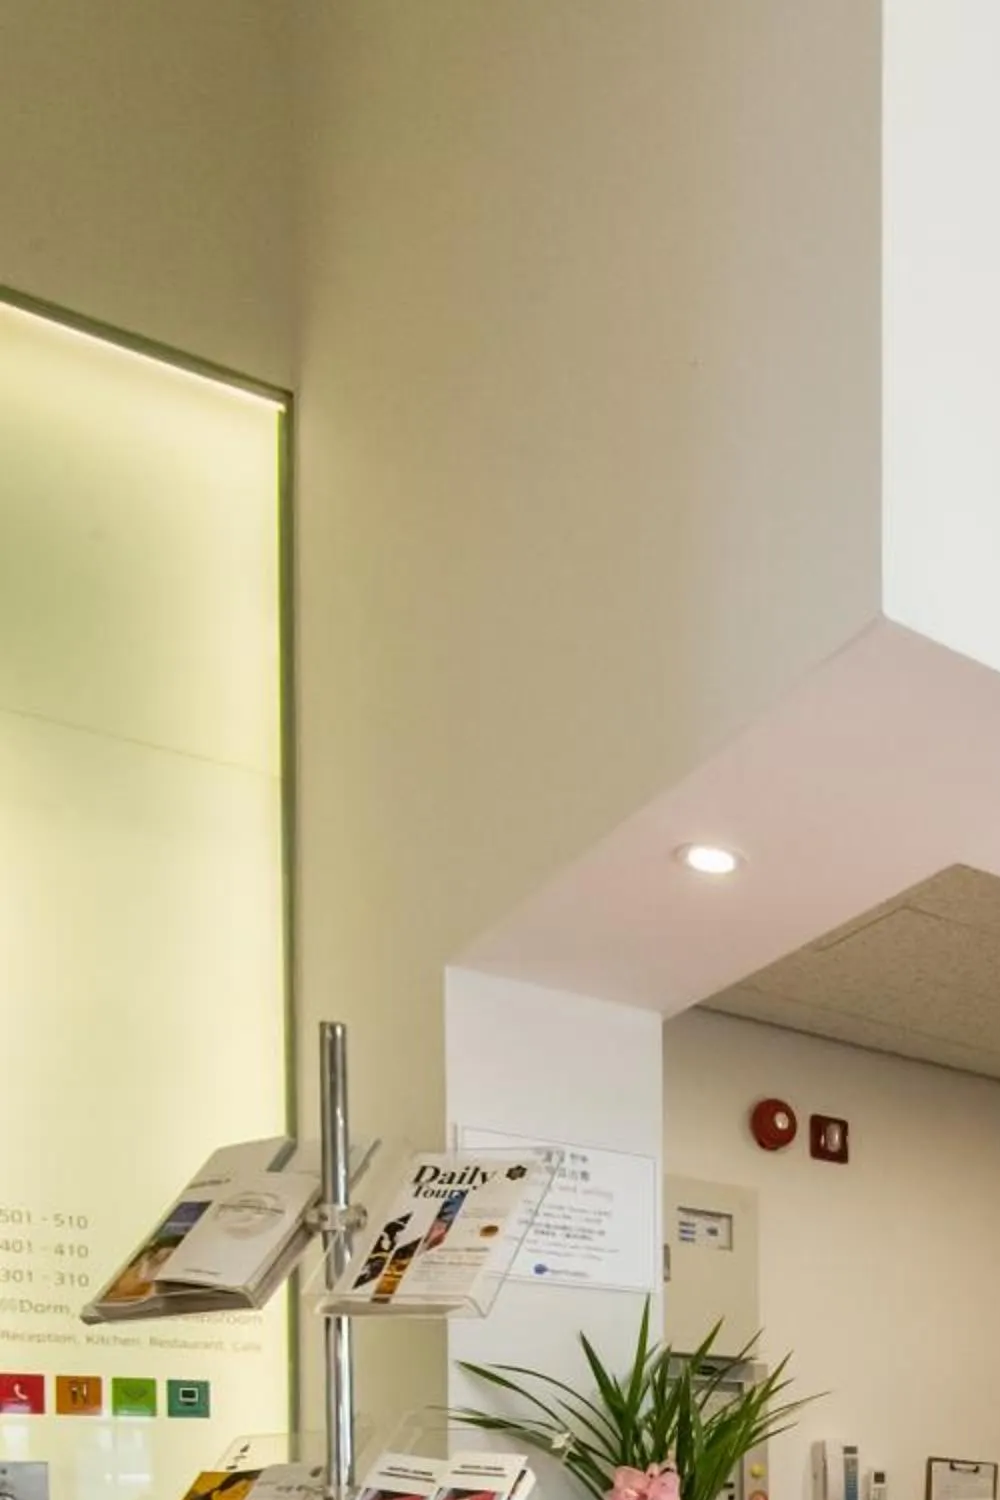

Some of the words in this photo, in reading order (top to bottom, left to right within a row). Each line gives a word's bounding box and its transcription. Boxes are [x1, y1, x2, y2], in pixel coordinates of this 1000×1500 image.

[412, 1163, 497, 1190] Daily
[0, 1208, 32, 1225] 501
[53, 1213, 88, 1230] 510
[54, 1243, 89, 1259] 410
[0, 1268, 33, 1283] 301
[54, 1272, 90, 1287] 310
